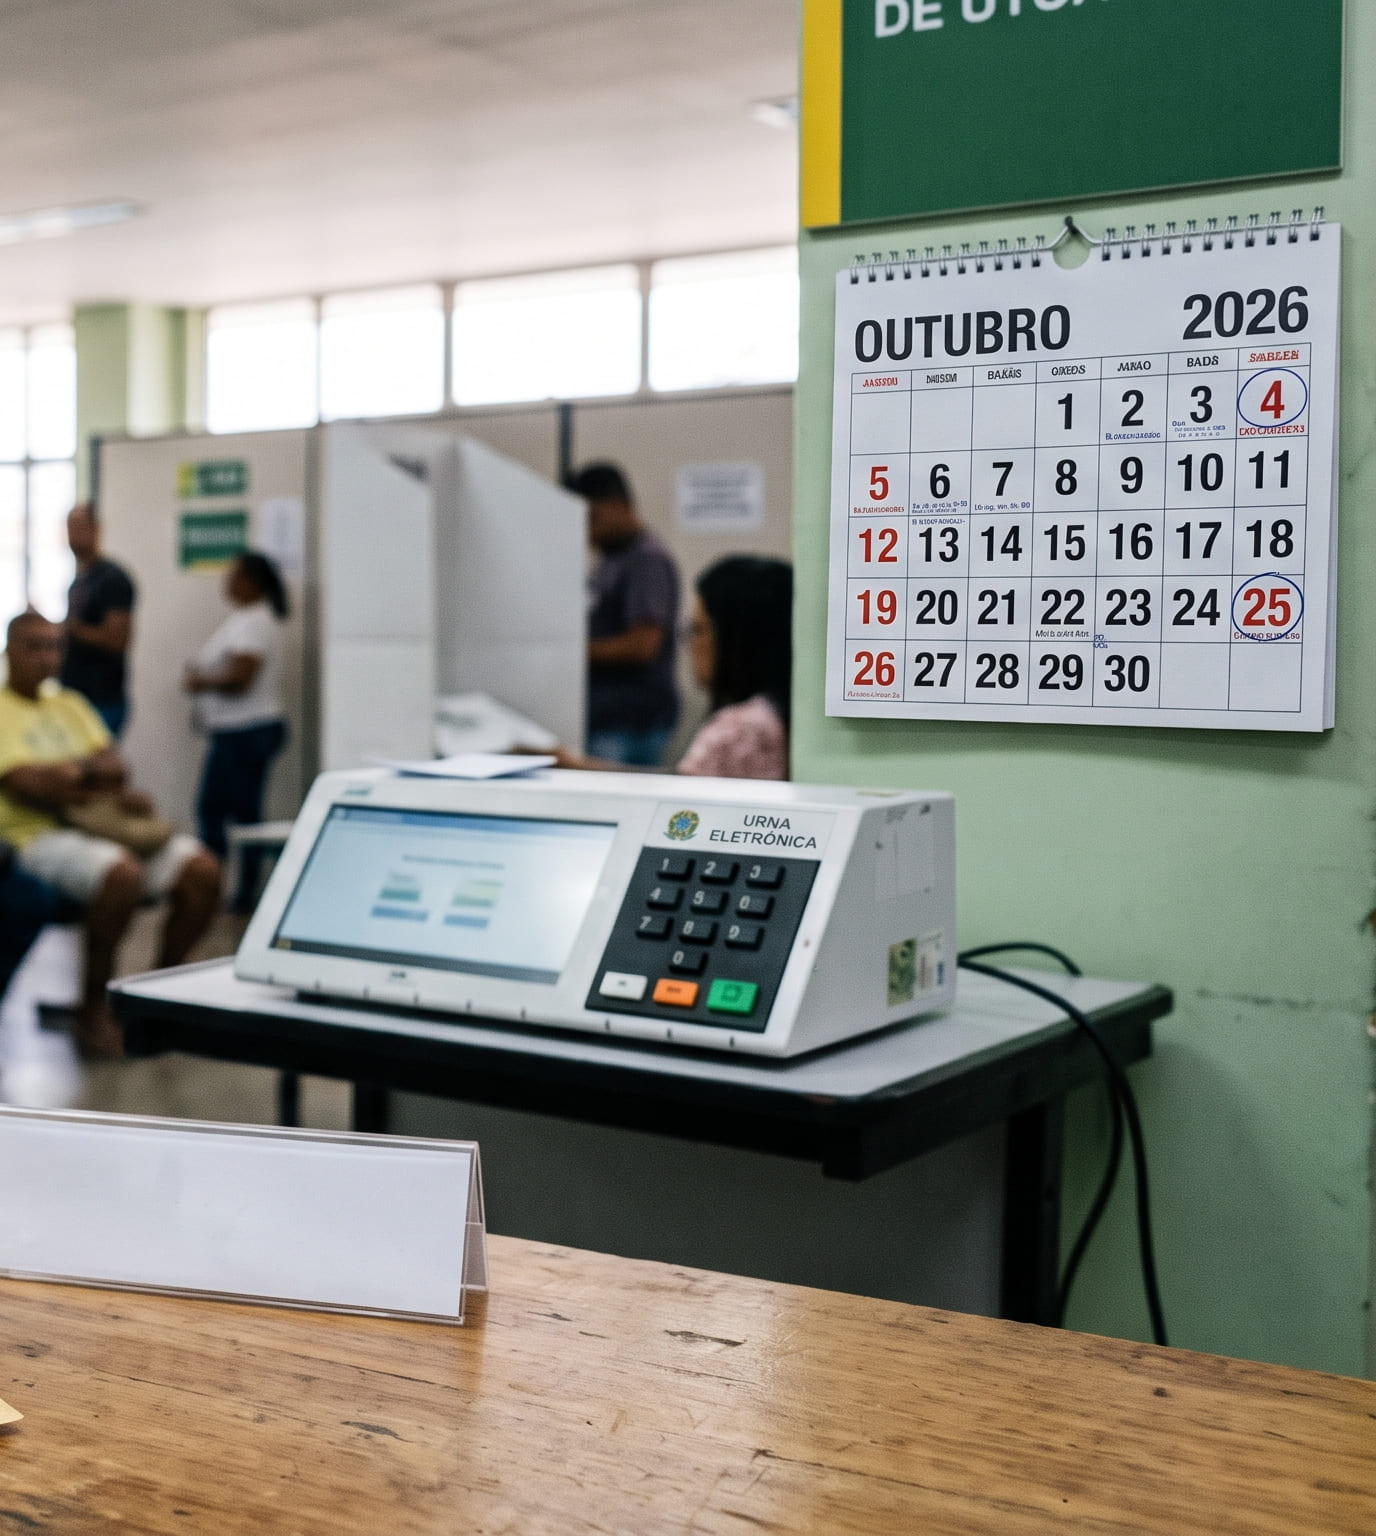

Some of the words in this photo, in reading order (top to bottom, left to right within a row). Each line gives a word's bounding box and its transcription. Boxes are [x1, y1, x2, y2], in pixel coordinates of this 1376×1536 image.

[875, 0, 944, 38] DE
[855, 305, 1070, 362] OUTUBRO
[1183, 286, 1308, 339] 2026
[1058, 394, 1072, 429] 1
[1122, 390, 1143, 426] 2
[1190, 386, 1212, 422] 3
[1261, 381, 1284, 418] 4
[870, 466, 888, 500] 5
[930, 464, 950, 498] 6
[993, 462, 1013, 496] 7
[1056, 460, 1077, 495] 8
[1121, 457, 1143, 493] 9
[1178, 453, 1223, 491] 10
[1249, 450, 1289, 488] 11
[860, 528, 898, 562] 12
[919, 527, 958, 562] 13
[981, 526, 1022, 561] 14
[1045, 525, 1085, 560] 15
[1110, 523, 1152, 560] 16
[1176, 522, 1221, 559] 17
[1247, 520, 1293, 557] 18
[858, 590, 896, 624] 19
[916, 590, 957, 625] 20
[978, 590, 1014, 624] 21
[1041, 589, 1084, 624] 22
[1106, 589, 1151, 626] 23
[1173, 589, 1220, 625] 24
[1243, 588, 1290, 626] 25
[854, 651, 894, 686] 26
[914, 652, 957, 687] 27
[976, 653, 1019, 688] 28
[1039, 654, 1083, 690] 29
[1105, 655, 1149, 692] 30
[743, 814, 792, 830] URNA
[662, 858, 669, 871] 1
[704, 861, 717, 875] 2
[692, 890, 705, 905] 5
[672, 950, 684, 965] 0
